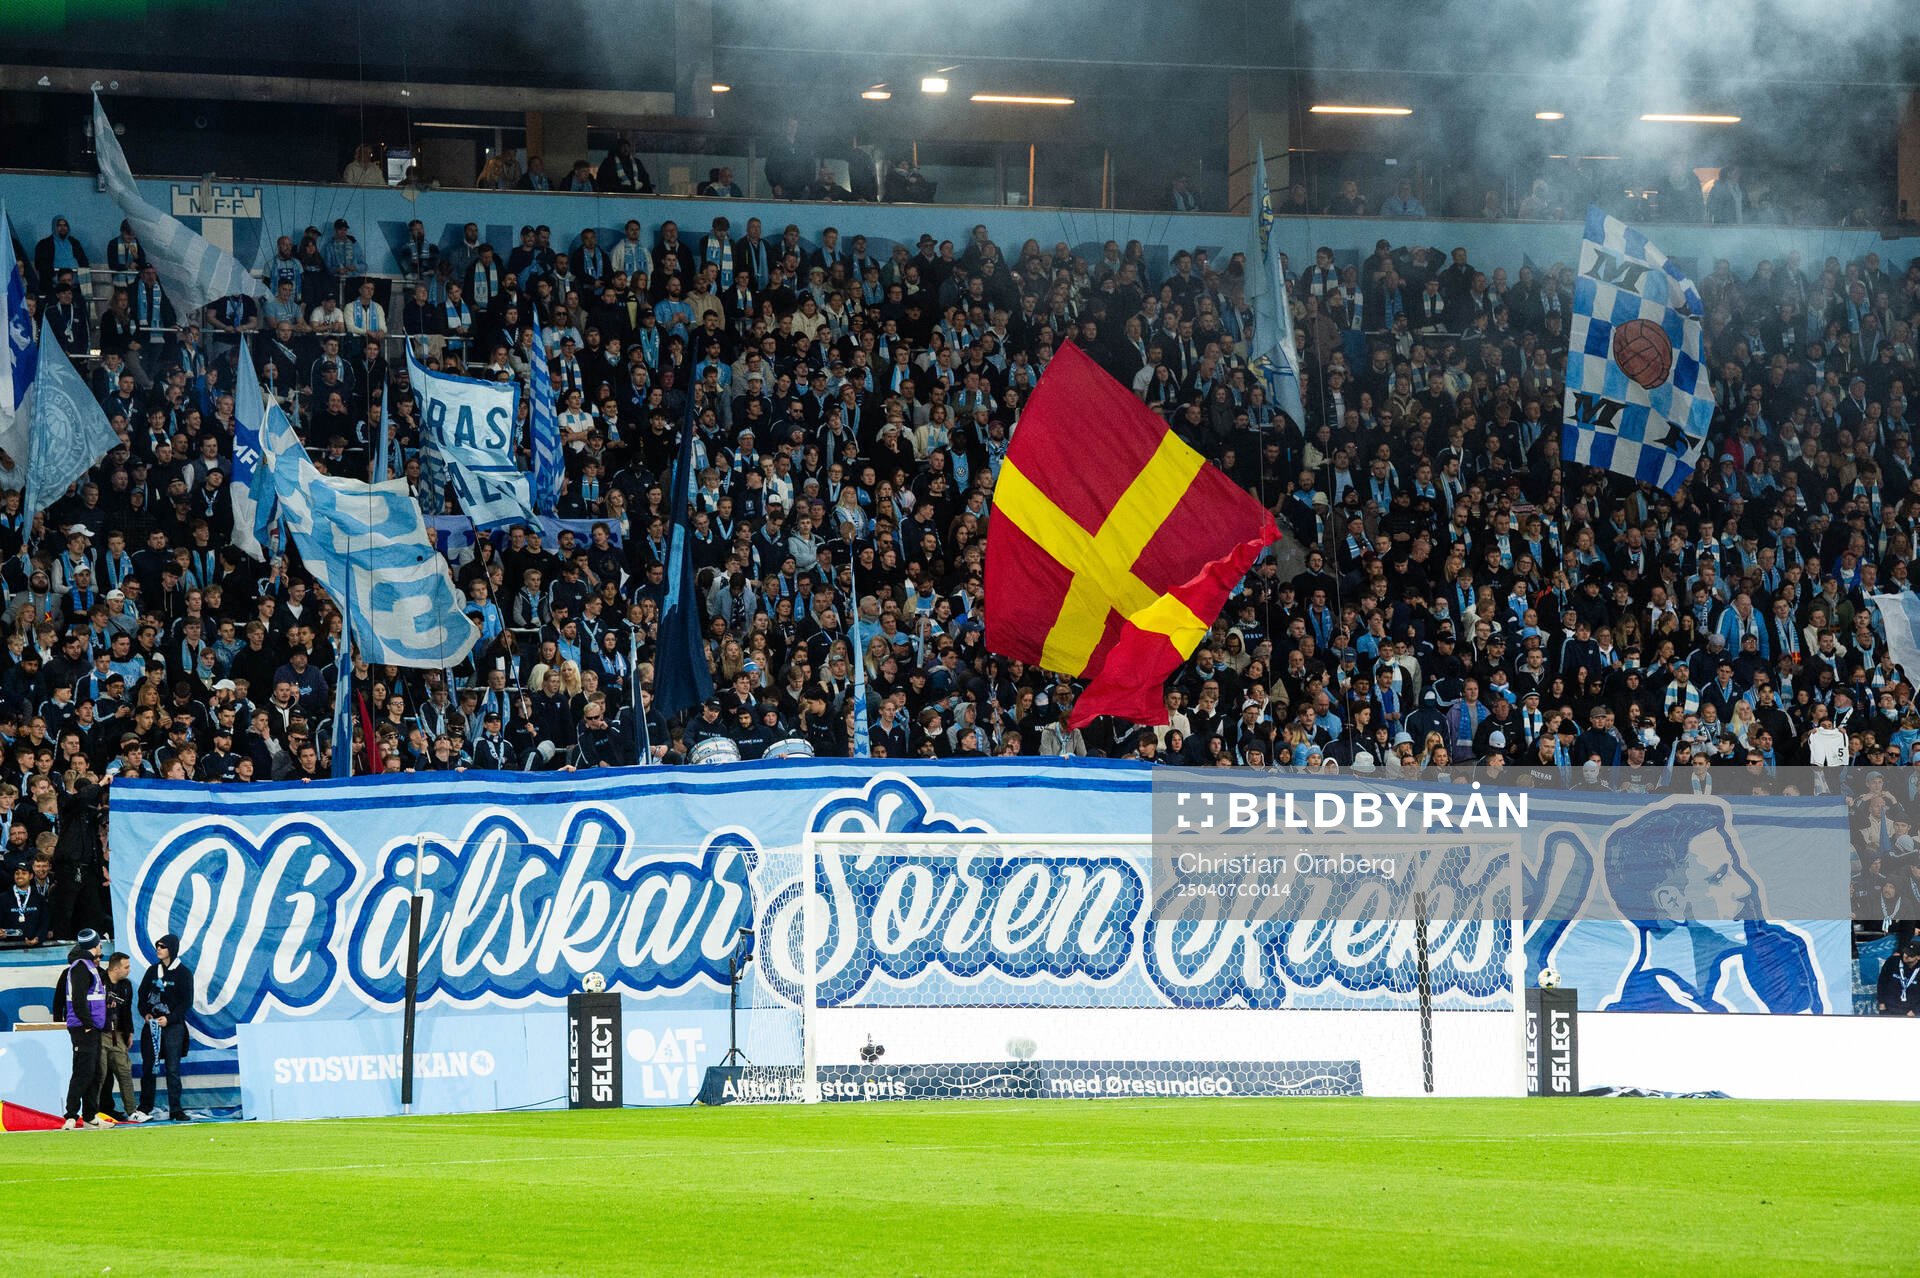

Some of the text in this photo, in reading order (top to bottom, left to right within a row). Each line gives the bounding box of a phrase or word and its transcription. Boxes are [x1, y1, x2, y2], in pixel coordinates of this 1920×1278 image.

[1838, 748, 1844, 757] 5
[142, 828, 340, 1015] Vi
[356, 814, 750, 984] älskar
[570, 1016, 579, 1102] SELECT
[591, 1015, 613, 1101] SELECT
[864, 1075, 907, 1102] pris
[1051, 1075, 1233, 1096] med ØresundGO
[1526, 1009, 1539, 1092] SELECT
[1550, 1009, 1571, 1092] SELECT
